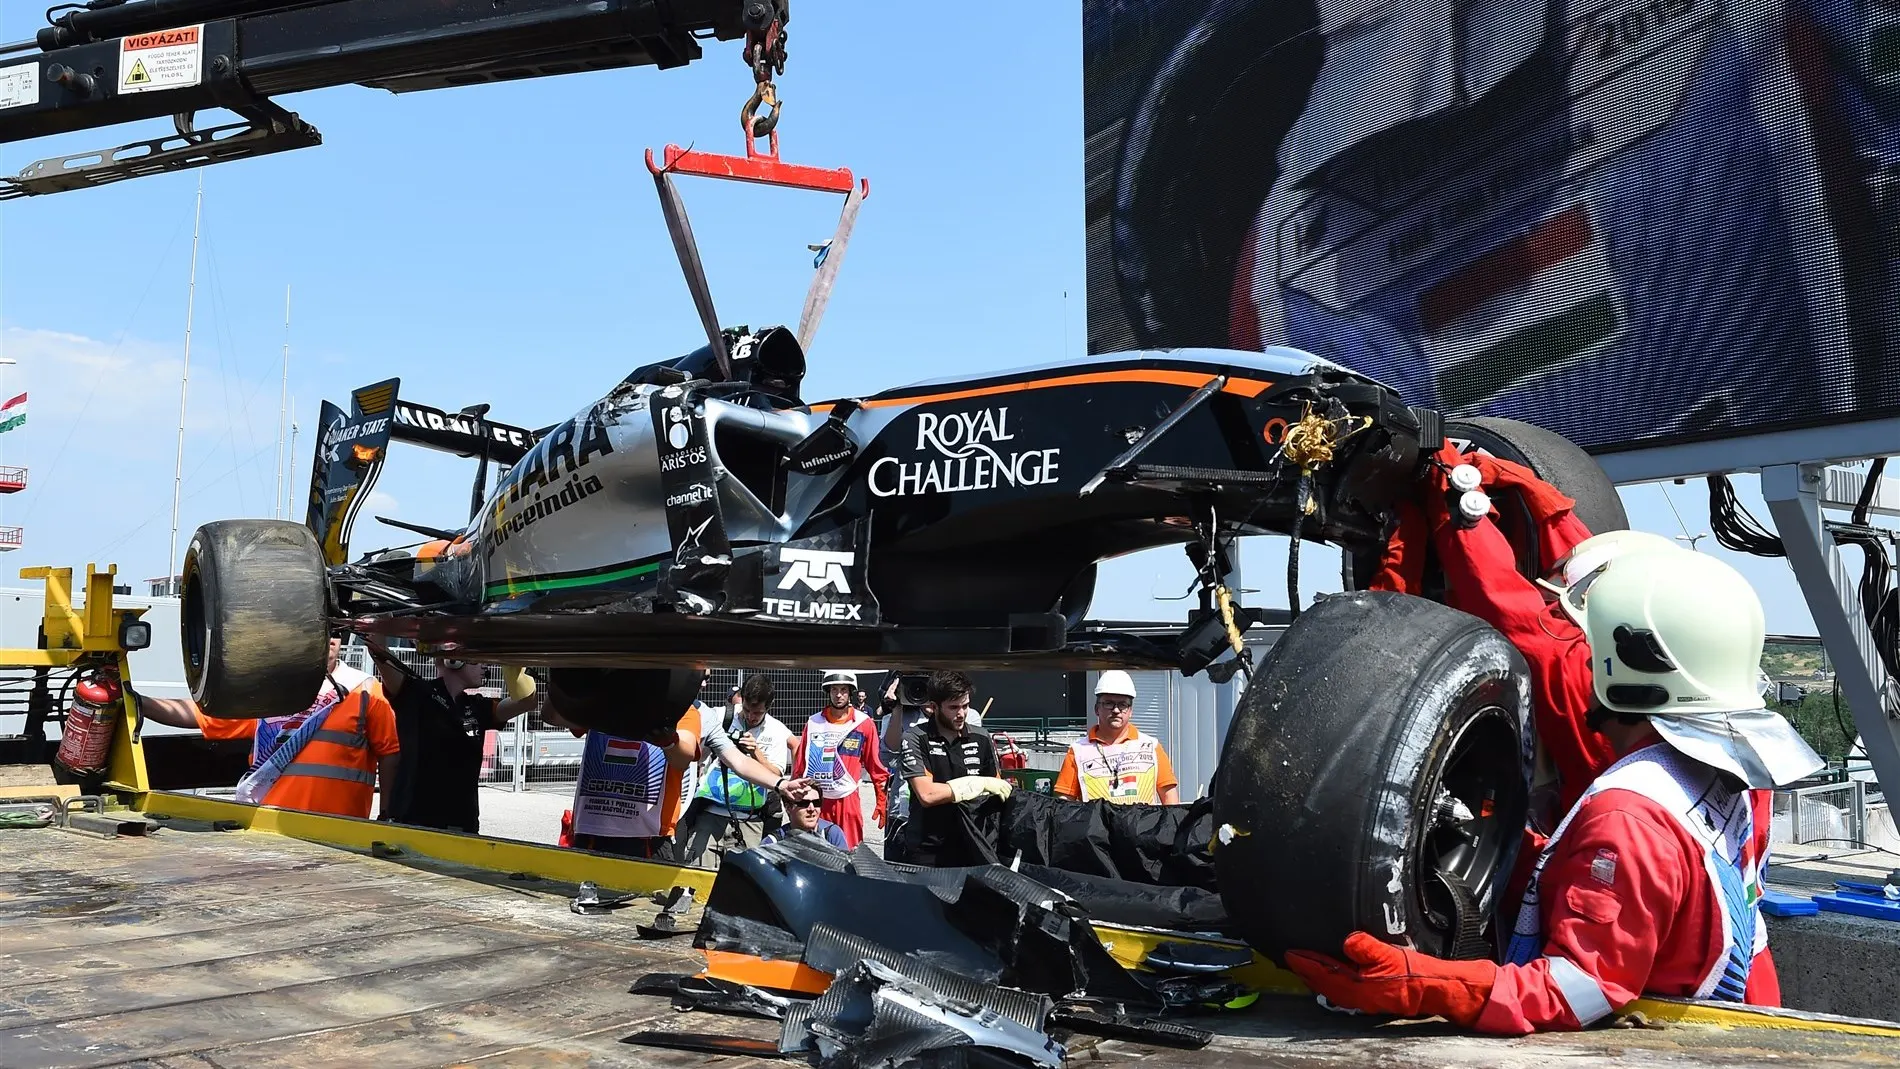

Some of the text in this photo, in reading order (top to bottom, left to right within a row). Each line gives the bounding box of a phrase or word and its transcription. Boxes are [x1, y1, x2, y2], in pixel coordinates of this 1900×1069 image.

[128, 31, 195, 48] VIGYÁZAT!
[360, 417, 389, 437] STATE
[916, 406, 1014, 454] ROYAL
[801, 448, 851, 469] infinitum
[868, 447, 1060, 498] CHALLENGE
[762, 597, 862, 621] TELMEX
[1603, 657, 1613, 677] 1
[587, 779, 647, 798] COURSE
